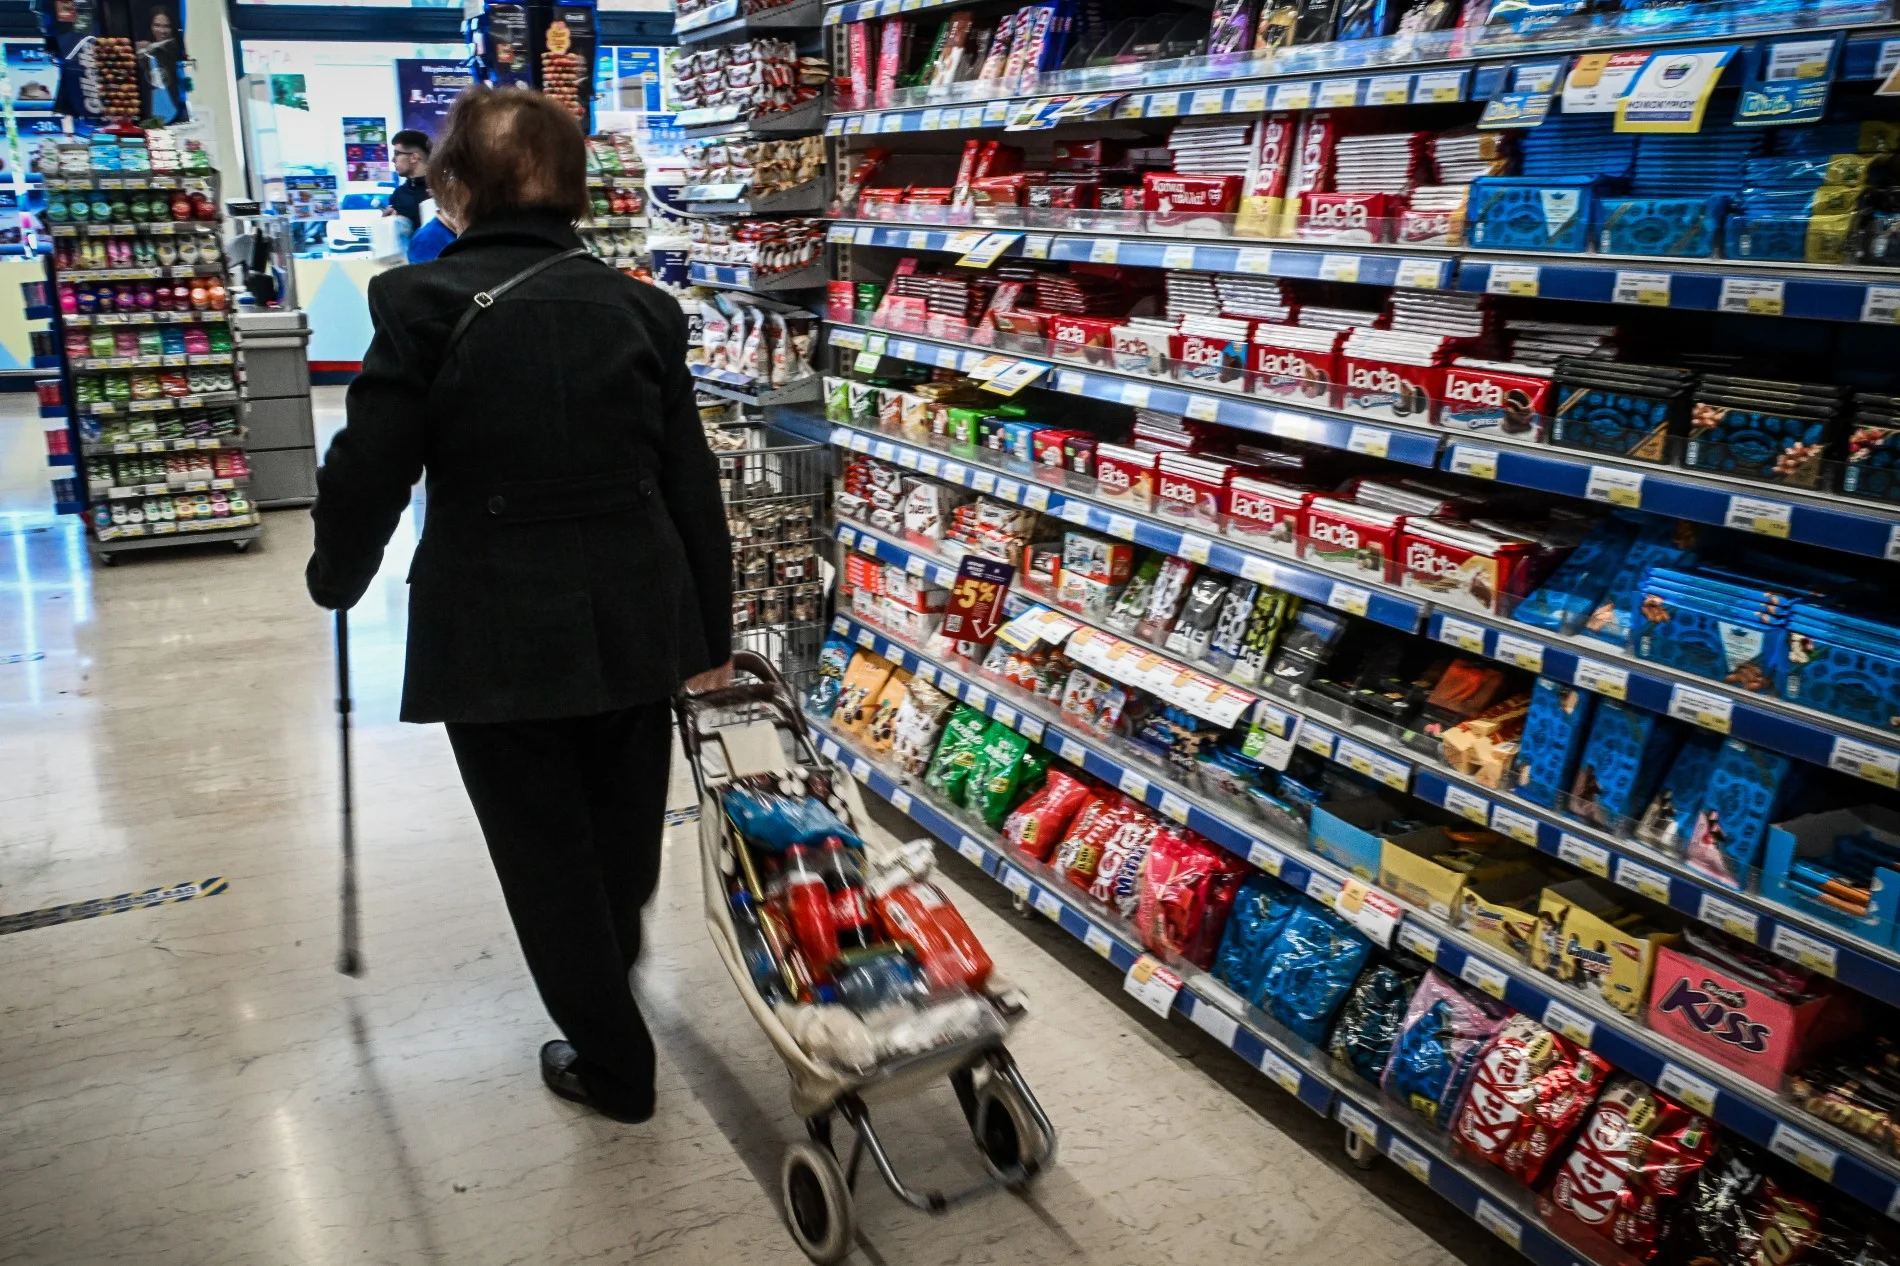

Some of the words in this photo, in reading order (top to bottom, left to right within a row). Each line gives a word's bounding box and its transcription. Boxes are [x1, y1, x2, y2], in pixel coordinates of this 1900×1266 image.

[1310, 198, 1369, 227] lacta
[1054, 322, 1086, 343] lacta
[1183, 340, 1223, 365] lacta
[1258, 349, 1306, 377] lacta
[1347, 363, 1401, 393] lacta
[1445, 374, 1502, 406] lacta
[1098, 467, 1130, 488] lacta
[1160, 478, 1196, 504] lacta
[1230, 491, 1275, 523] lacta
[1308, 516, 1360, 549] lacta
[1406, 546, 1460, 577] lacta
[953, 579, 996, 608] -5%
[1658, 976, 1773, 1054] KISS
